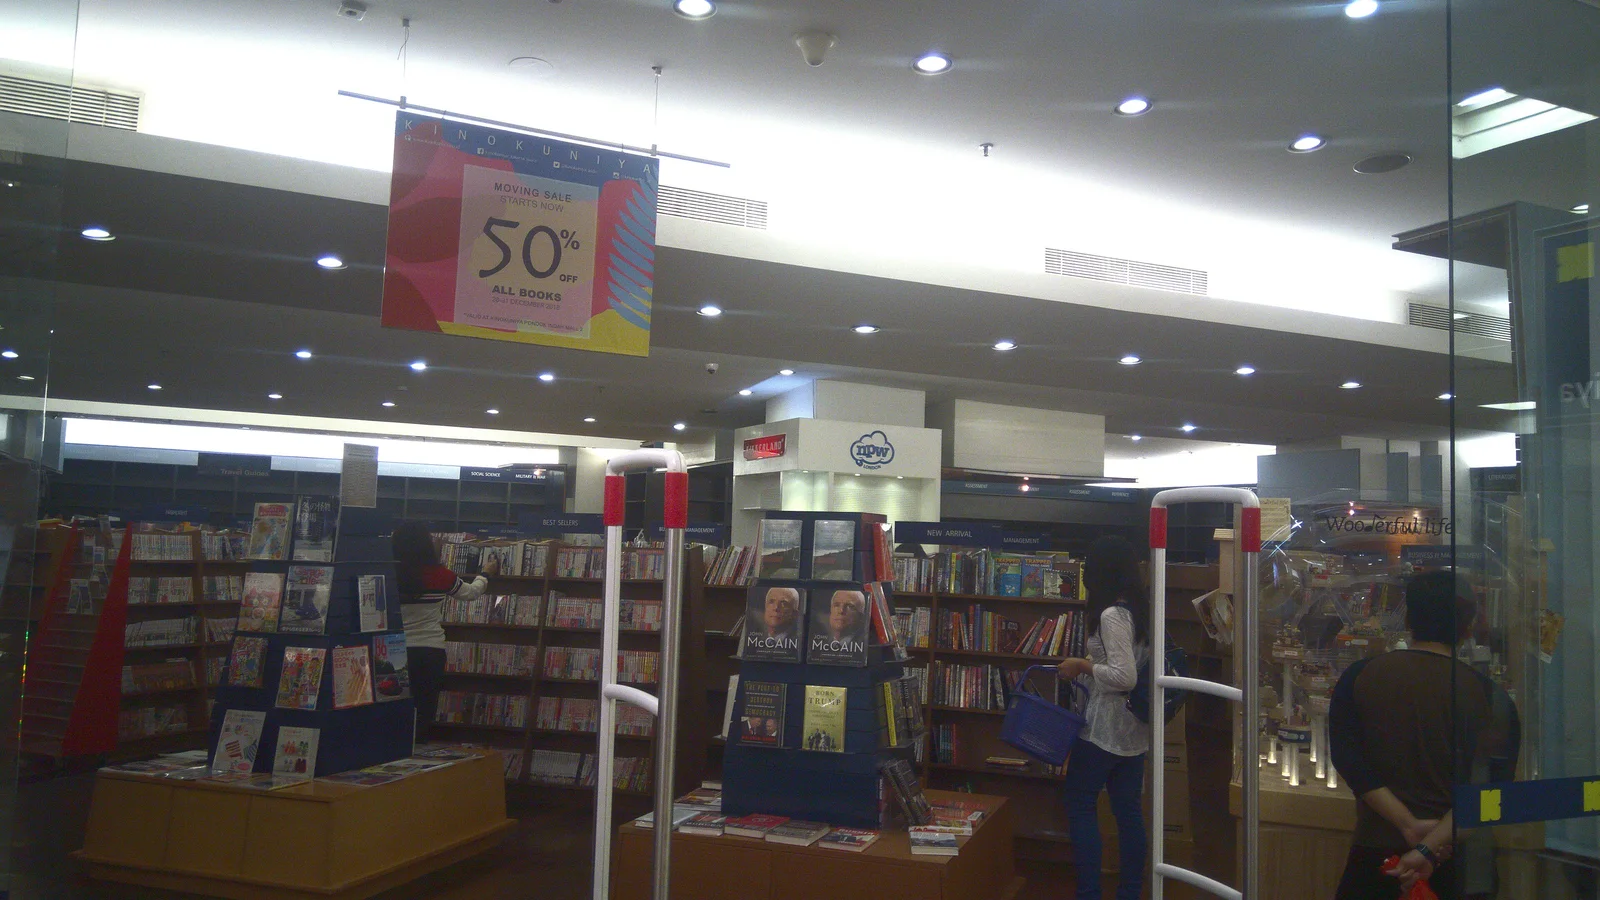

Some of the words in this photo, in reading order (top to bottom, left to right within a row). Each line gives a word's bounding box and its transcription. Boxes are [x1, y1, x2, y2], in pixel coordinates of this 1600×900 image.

[404, 120, 651, 174] KINOKUNIYA
[494, 182, 539, 198] MOVING
[544, 190, 572, 203] SALE
[500, 195, 538, 209] STARTS
[540, 202, 564, 212] NOW
[559, 274, 578, 284] OFF
[492, 284, 515, 296] ALL
[519, 288, 562, 302] BOOKS
[510, 298, 544, 308] DECEMBER
[856, 444, 890, 458] npw
[220, 468, 242, 476] Travel
[1488, 473, 1517, 481] LITERATURE
[1425, 517, 1452, 536] life
[946, 530, 972, 538] ARRIVAL
[1440, 552, 1483, 560] MAAGEMENT
[747, 636, 798, 649] McCAIN
[812, 640, 864, 653] McCAIN
[808, 697, 842, 706] TRUMP
